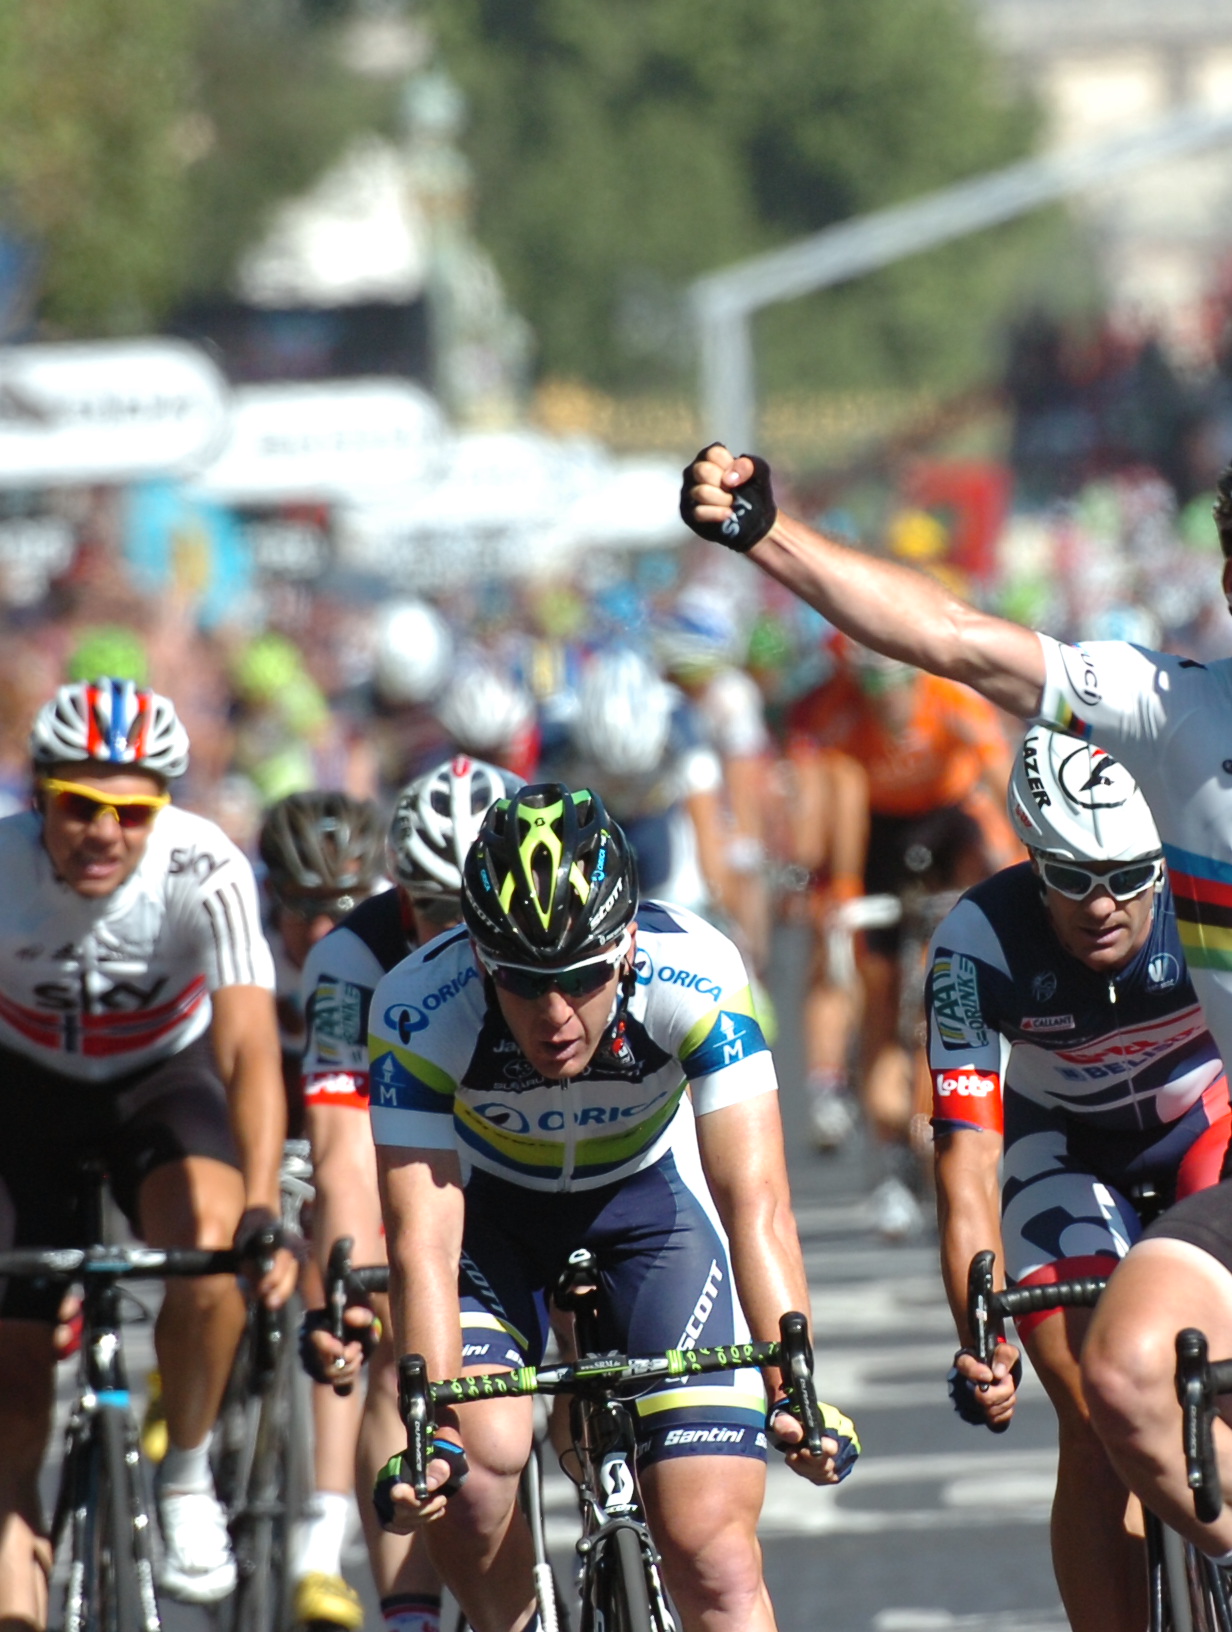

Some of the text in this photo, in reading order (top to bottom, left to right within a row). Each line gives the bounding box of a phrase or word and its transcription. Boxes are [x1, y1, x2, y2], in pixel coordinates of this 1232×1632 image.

[1023, 736, 1052, 810] LAZER
[422, 966, 479, 1011] ORICA
[657, 966, 723, 1002] ORICA
[677, 1258, 723, 1352] SCOTT
[664, 1427, 746, 1447] Santini
